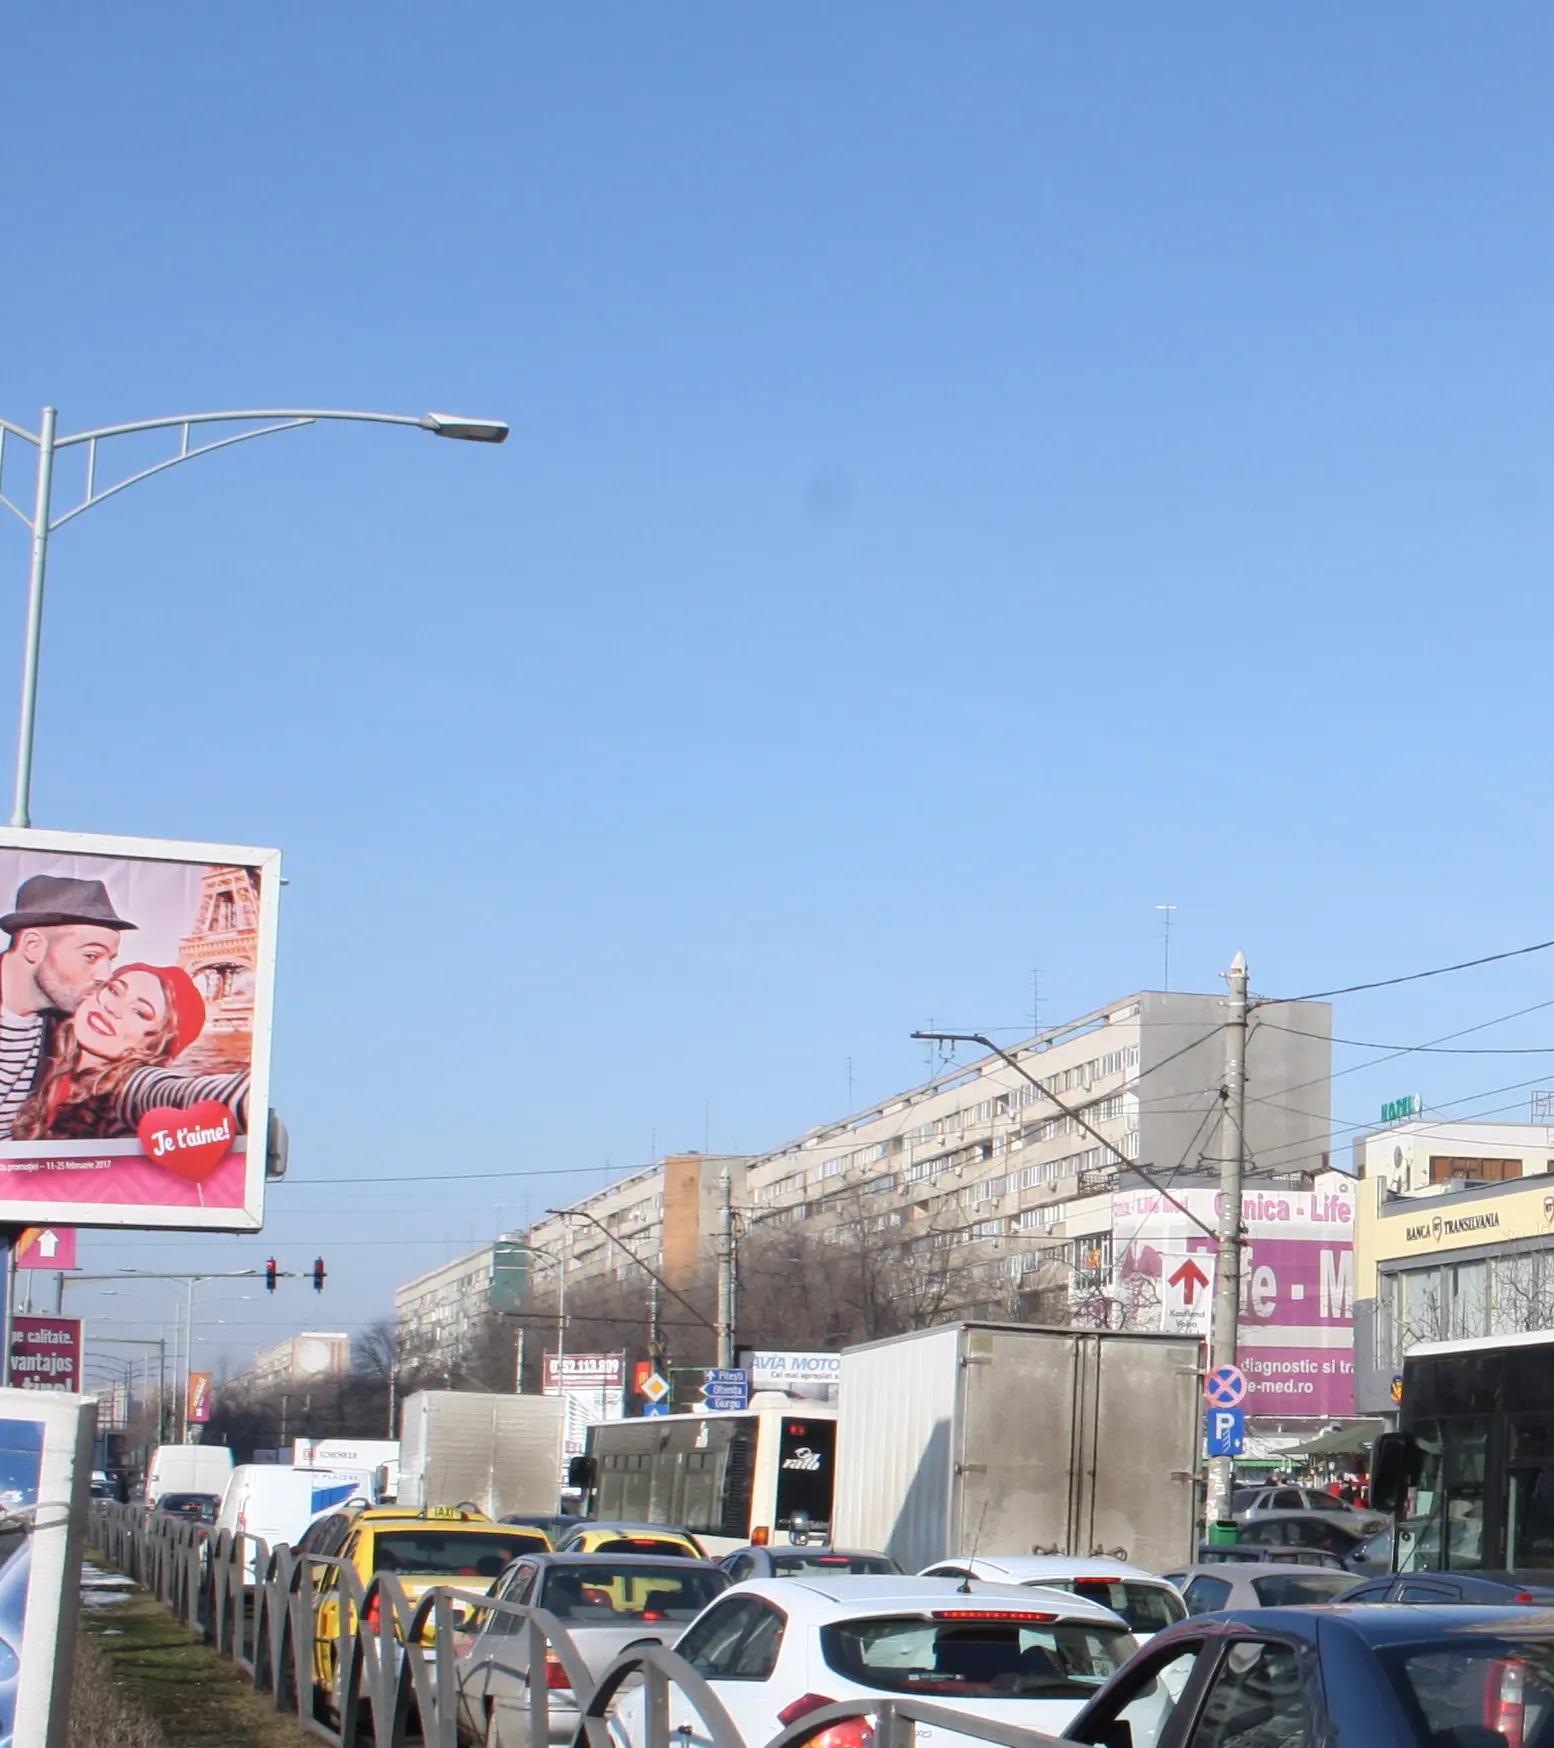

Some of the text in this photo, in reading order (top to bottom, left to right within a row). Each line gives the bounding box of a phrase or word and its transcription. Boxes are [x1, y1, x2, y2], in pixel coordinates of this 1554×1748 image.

[151, 1117, 231, 1157] Je t'aime!
[95, 1159, 112, 1169] 2017
[1311, 1194, 1352, 1222] Life
[1406, 1223, 1431, 1242] BANCA
[1444, 1212, 1500, 1236] TRANSILVANIA
[27, 1328, 74, 1345] calitate.
[1240, 1357, 1319, 1377] diagnostic
[1322, 1359, 1336, 1374] si
[1246, 1378, 1314, 1394] e-med.ro
[1215, 1412, 1235, 1440] P
